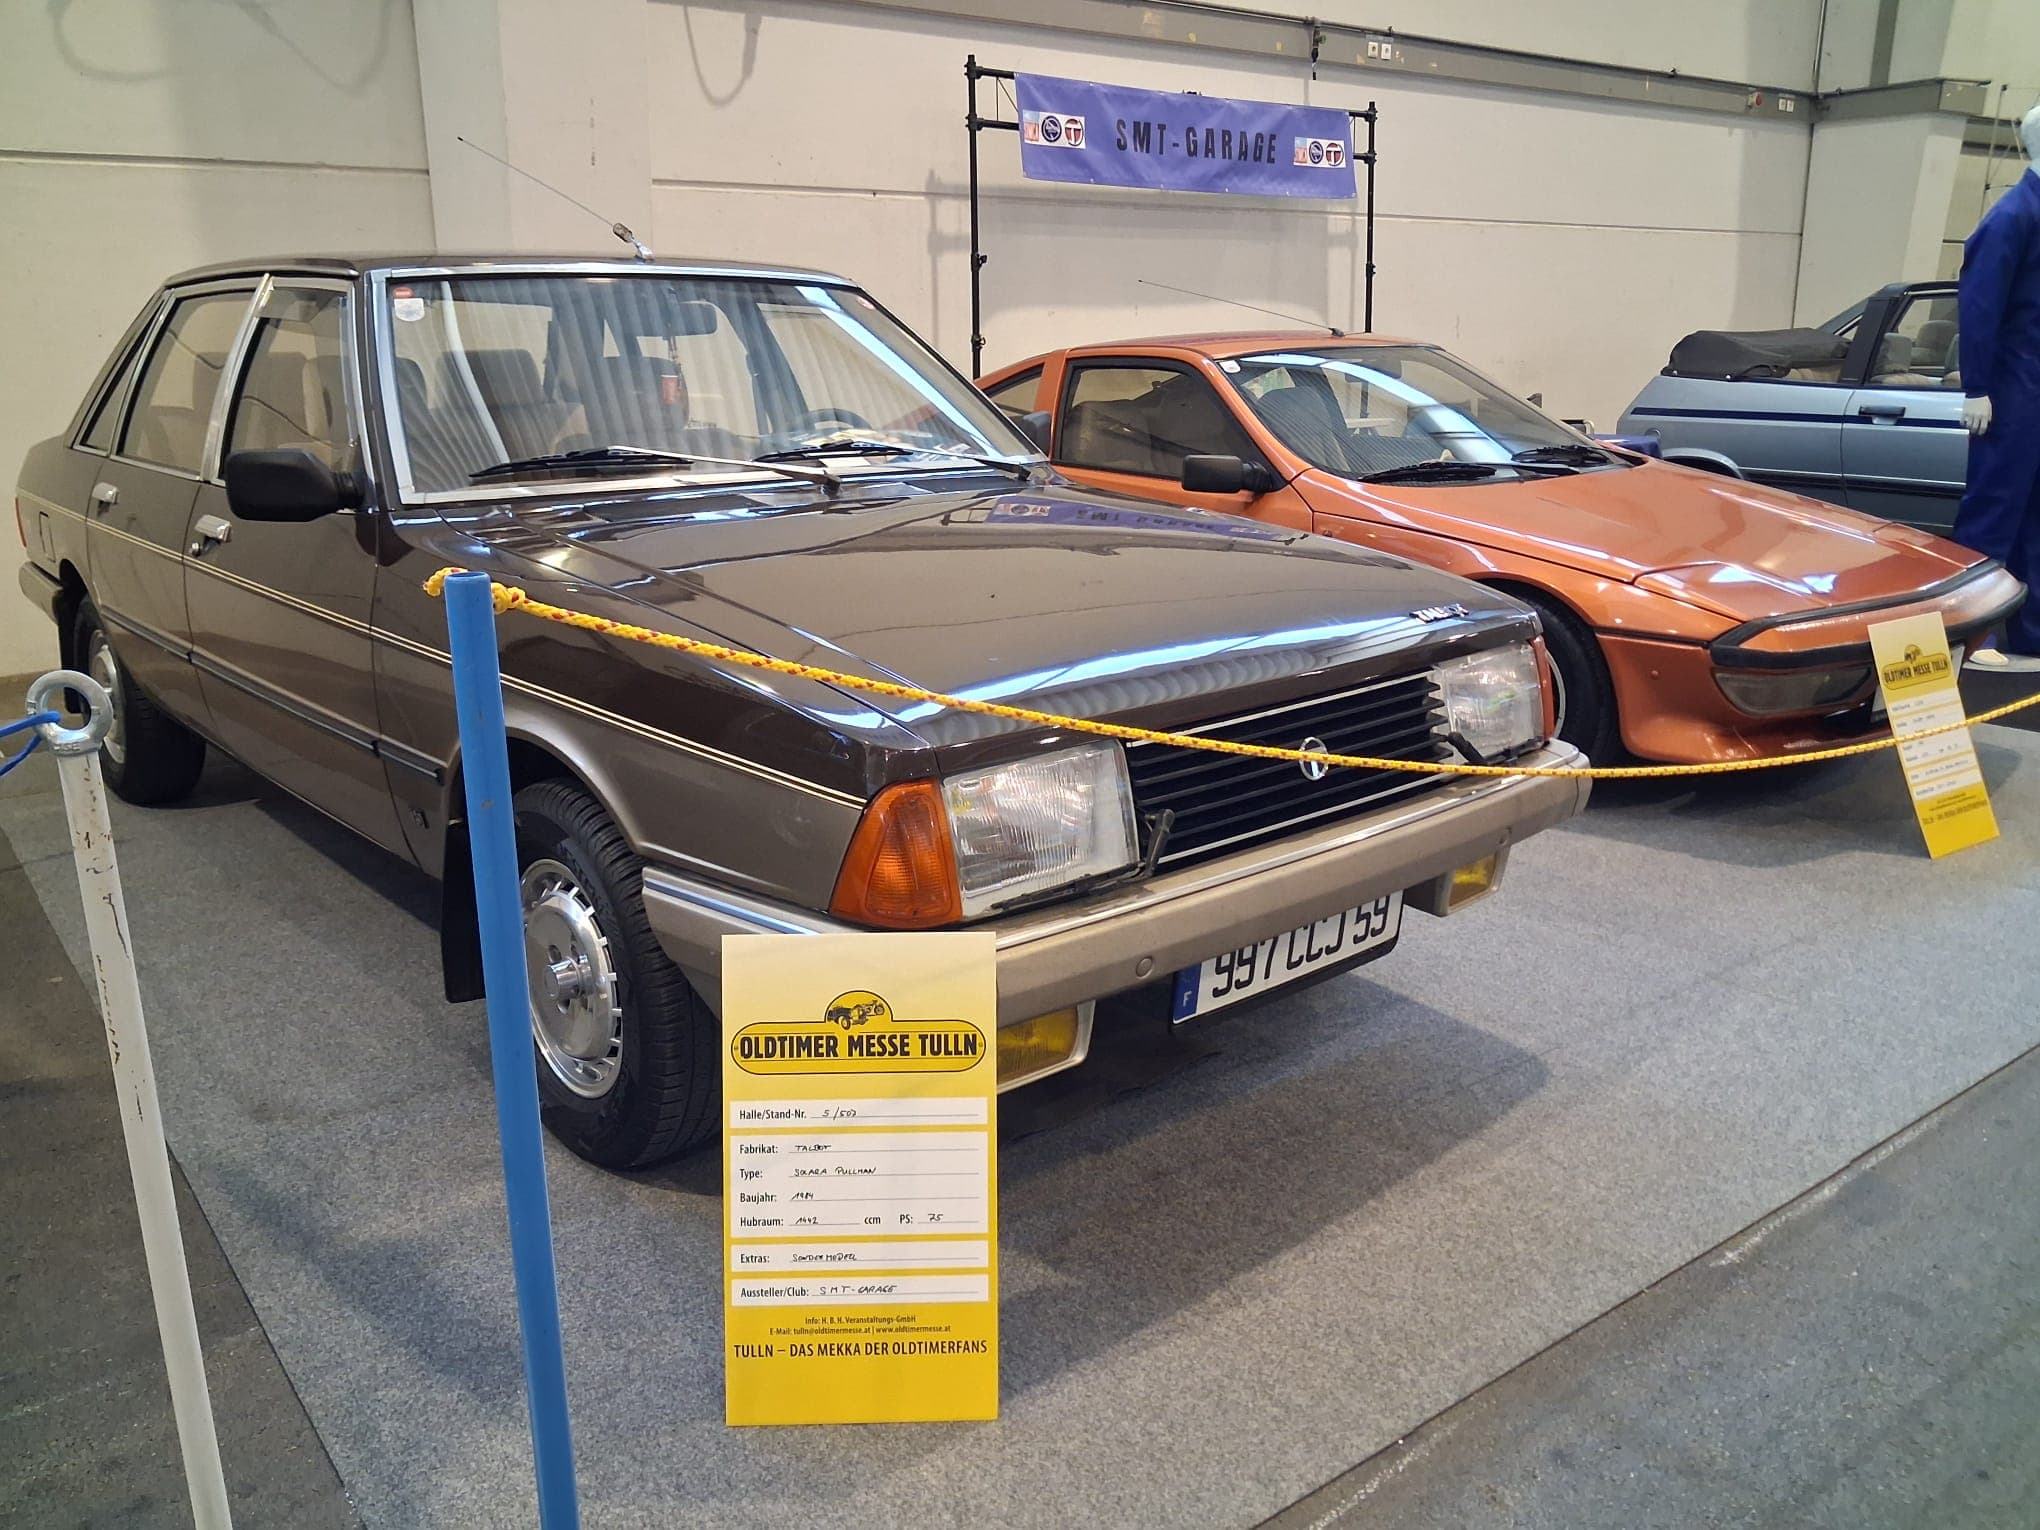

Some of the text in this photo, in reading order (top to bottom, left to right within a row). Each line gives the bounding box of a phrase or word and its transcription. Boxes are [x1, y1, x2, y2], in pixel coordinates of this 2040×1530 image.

[1116, 118, 1277, 164] SMT-GARAGE
[1884, 666, 1912, 684] OLDTIMER
[1913, 661, 1931, 676] MESSE
[1353, 896, 1390, 945] 59
[1182, 991, 1191, 1007] F
[740, 1033, 977, 1059] OLDTIMER MESSE TULLN
[739, 1109, 807, 1120] Halle/Stand-Nr.
[739, 1145, 778, 1154] Fabrikat:
[740, 1168, 763, 1182] Type:
[740, 1193, 777, 1204] Baujahr:
[740, 1215, 784, 1227] Hubraum:
[864, 1216, 881, 1224] ccm
[899, 1215, 913, 1224] PS:
[928, 1213, 943, 1222] 75
[740, 1253, 770, 1263] Extras:
[741, 1287, 809, 1297] Aussteller/Club:
[734, 1344, 773, 1357] TULLN
[790, 1344, 813, 1357] DAS
[817, 1343, 860, 1356] MEKKA
[865, 1342, 889, 1355] DER
[892, 1340, 987, 1355] OLDTIMERFANS
